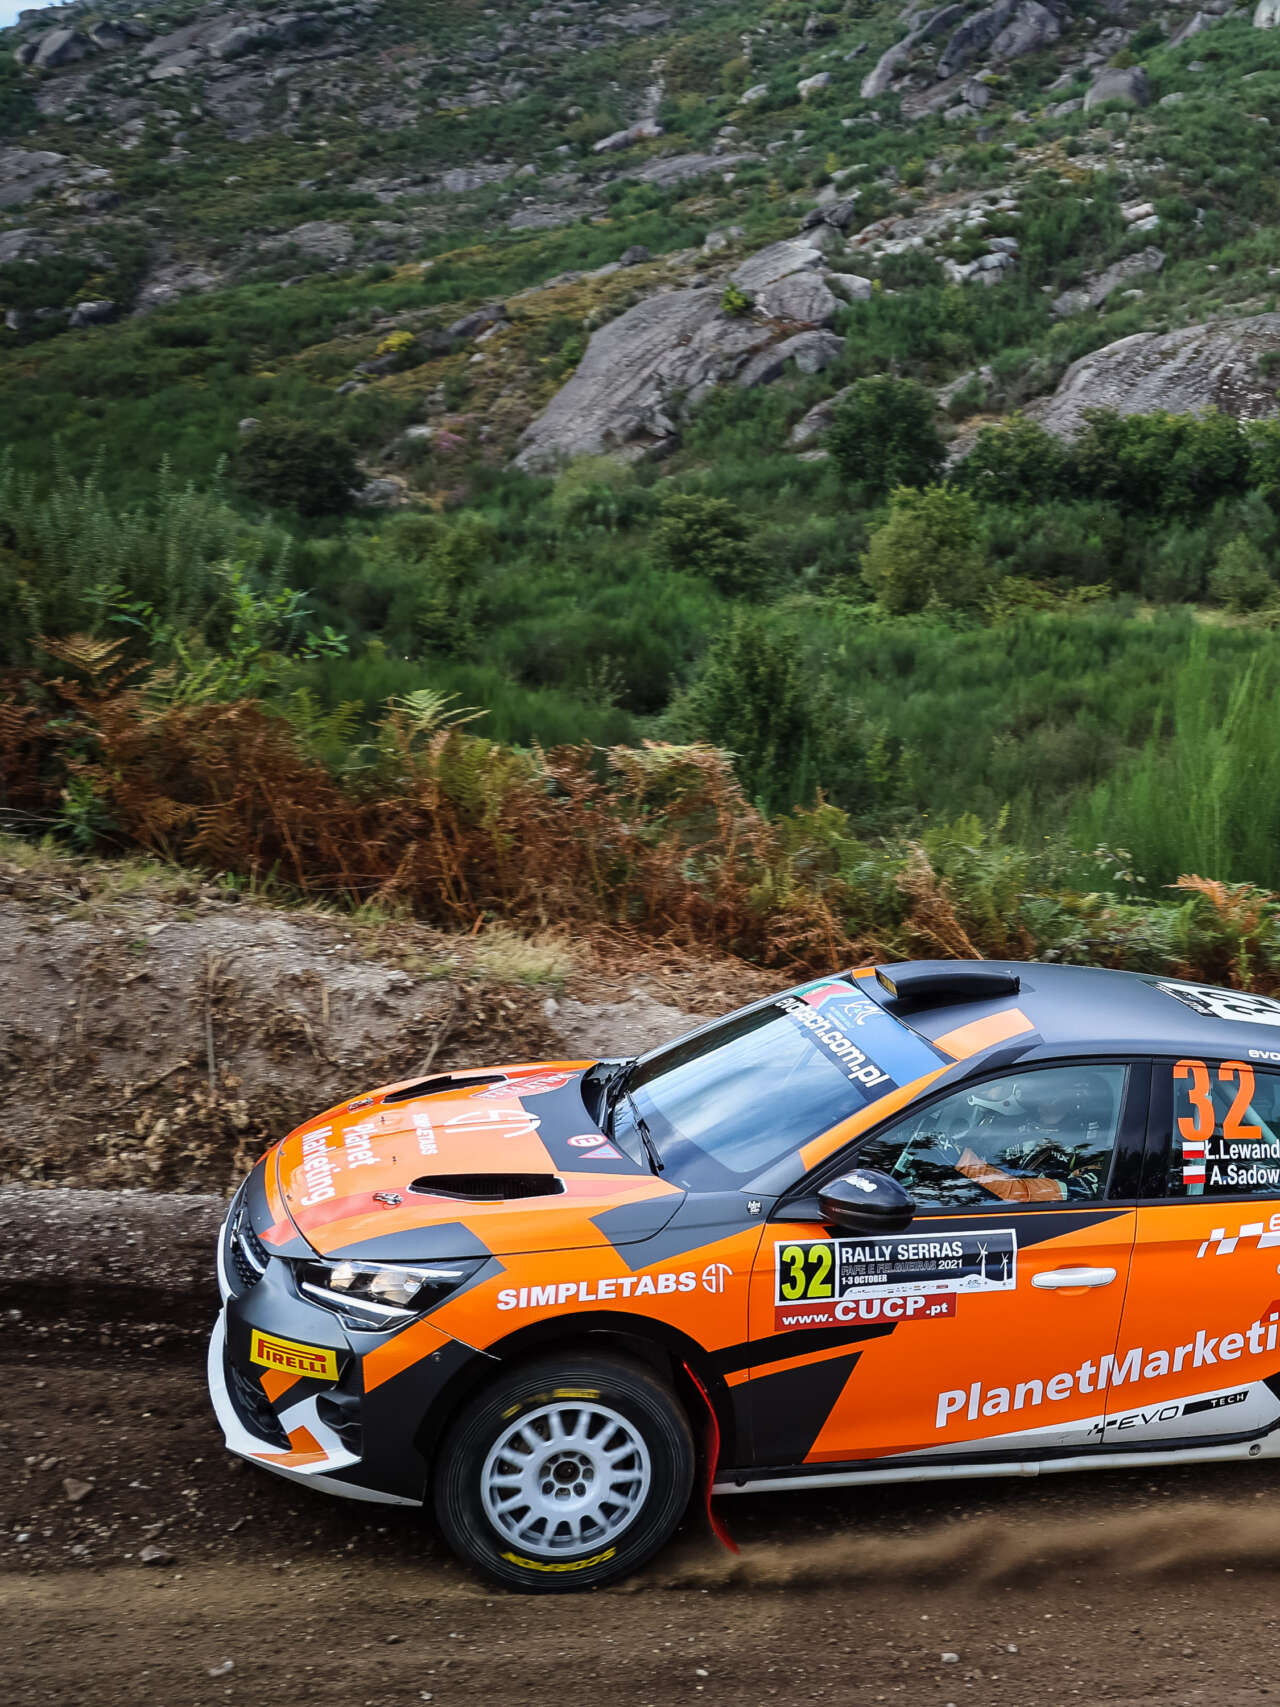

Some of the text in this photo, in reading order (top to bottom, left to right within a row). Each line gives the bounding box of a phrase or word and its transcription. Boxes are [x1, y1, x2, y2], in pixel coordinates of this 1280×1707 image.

[1173, 1060, 1262, 1141] 32
[343, 1123, 381, 1168] Planet
[301, 1126, 341, 1206] Marketing
[841, 1241, 963, 1264] RALLY SERRAS
[938, 1259, 963, 1270] 2021
[781, 1244, 832, 1300] 32
[841, 1274, 887, 1285] 1-3 OCTOBER
[496, 1271, 697, 1311] SIMPLETABS
[782, 1296, 948, 1325] www.CUCP.pt
[258, 1338, 327, 1374] PIRELLI
[1210, 1392, 1246, 1408] TECH
[1117, 1406, 1180, 1430] EVO
